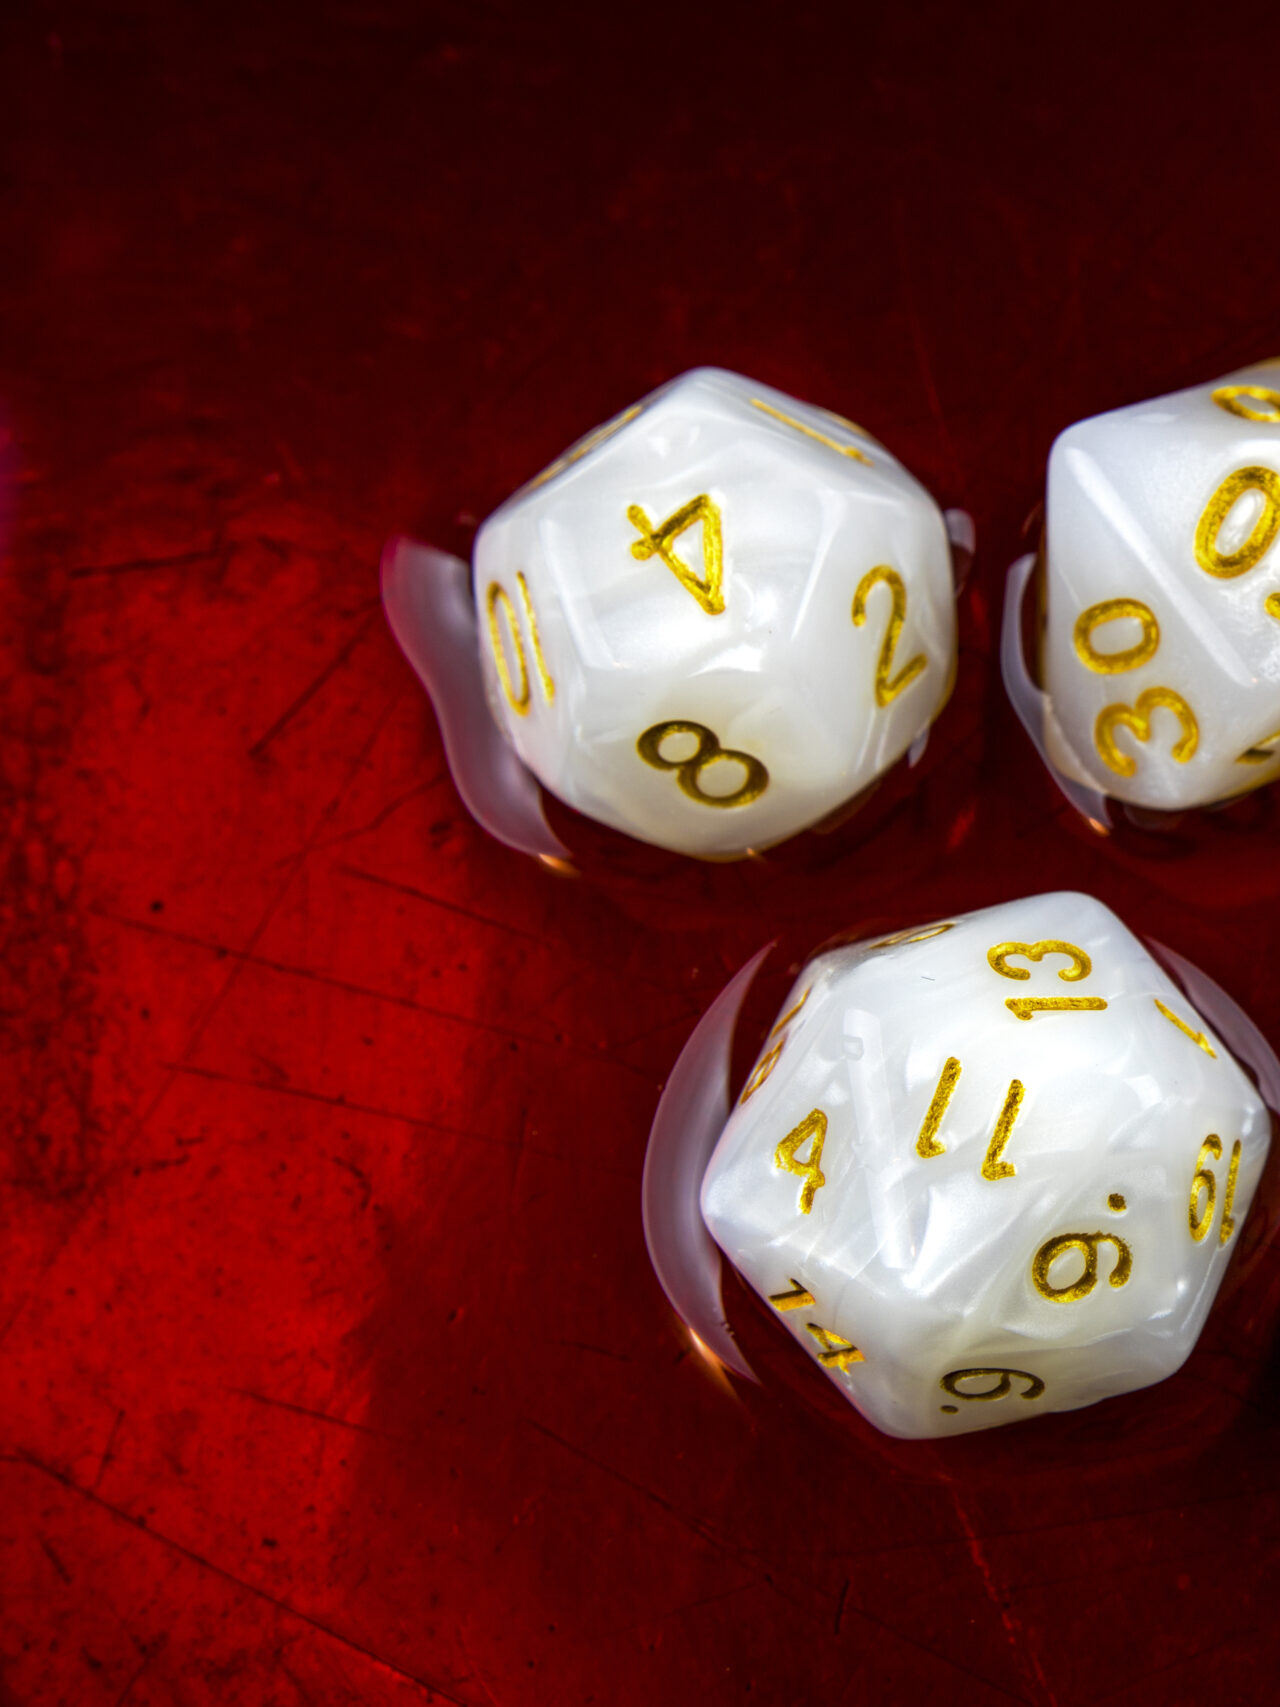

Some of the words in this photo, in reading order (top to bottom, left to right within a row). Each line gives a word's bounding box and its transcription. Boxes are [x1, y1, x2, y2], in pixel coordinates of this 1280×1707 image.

[626, 493, 725, 616] 4
[486, 570, 555, 717] 10
[850, 564, 929, 709] 2
[1073, 597, 1201, 779] 30
[635, 719, 771, 810] 8
[986, 940, 1109, 1022] 13
[774, 1108, 828, 1215] 4
[914, 1056, 1026, 1182] 11
[767, 1277, 866, 1376] 14
